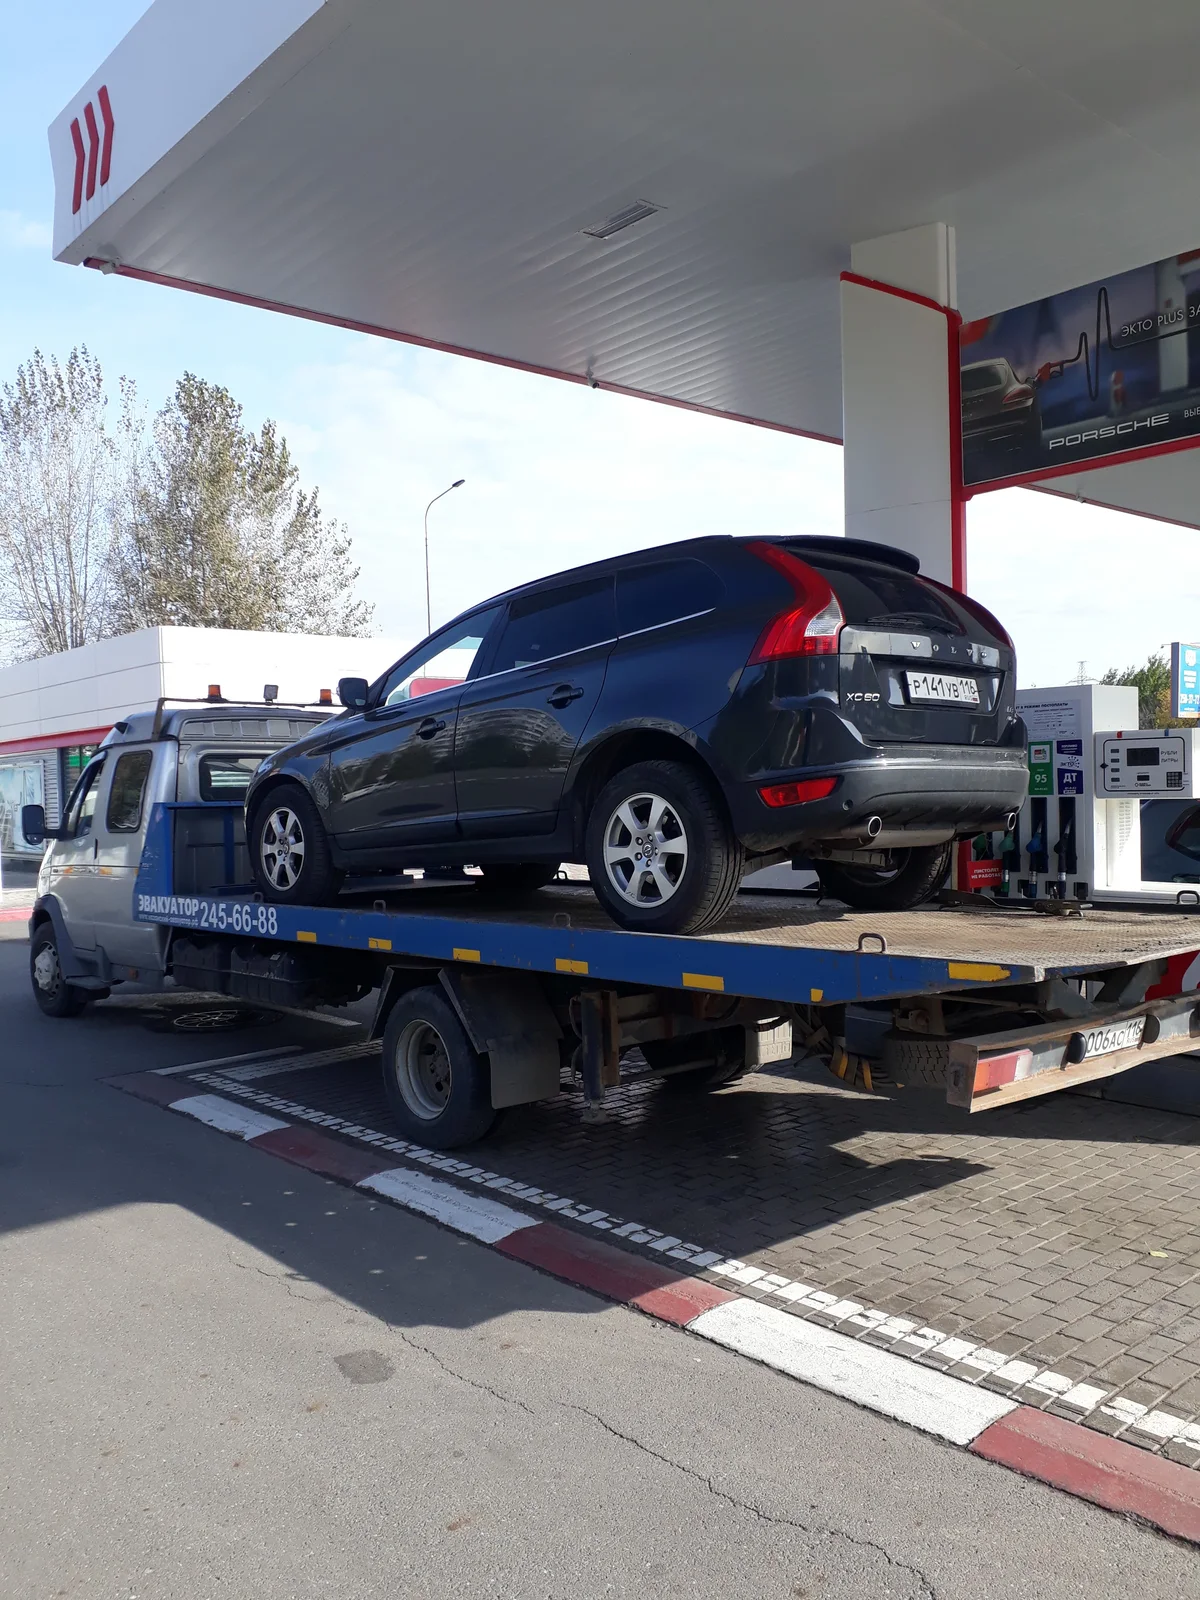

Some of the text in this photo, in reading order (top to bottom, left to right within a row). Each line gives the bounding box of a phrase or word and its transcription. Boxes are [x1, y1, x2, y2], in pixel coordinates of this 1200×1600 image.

[1121, 319, 1153, 337] ЭКТО
[1157, 306, 1184, 327] PLUS
[1049, 413, 1170, 450] PORSCHE
[846, 692, 881, 702] XC60
[1034, 774, 1048, 783] 95
[1063, 773, 1078, 784] ДТ
[138, 894, 199, 916] ЭВАКУАТОР
[200, 901, 278, 935] 245-66-88
[1086, 1028, 1125, 1054] 006АС
